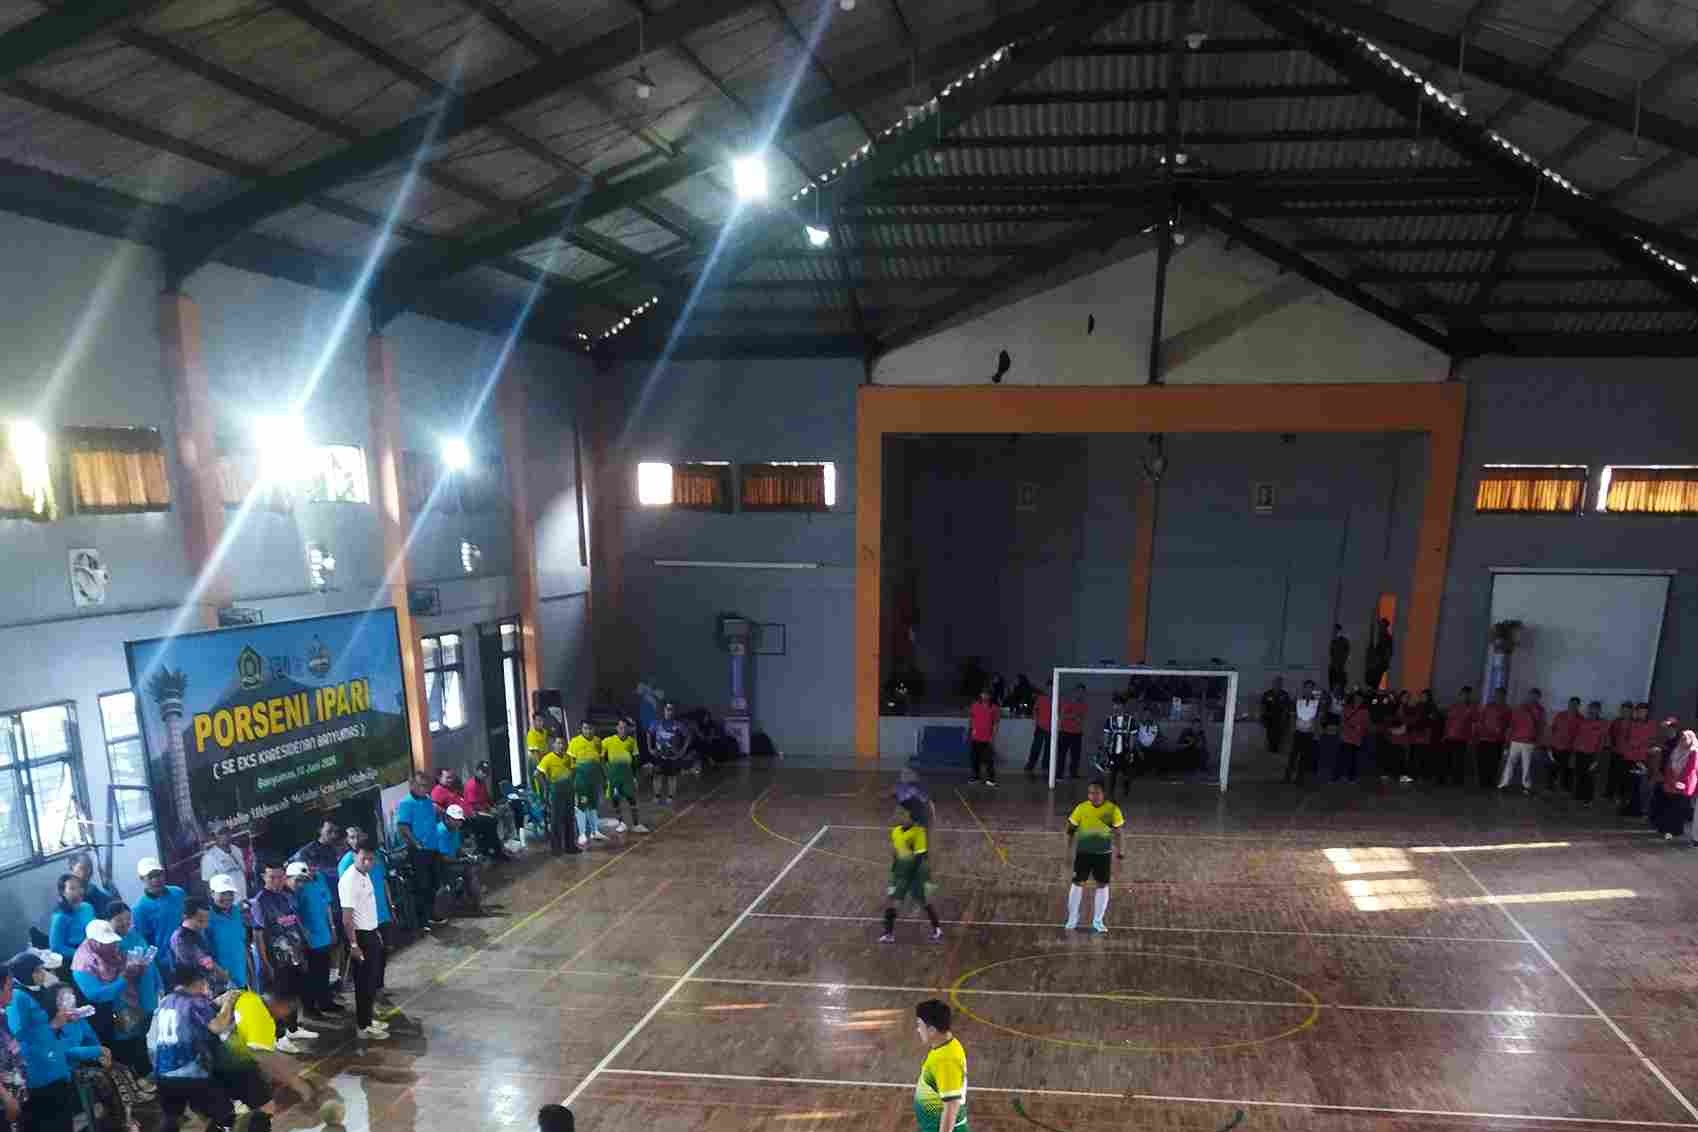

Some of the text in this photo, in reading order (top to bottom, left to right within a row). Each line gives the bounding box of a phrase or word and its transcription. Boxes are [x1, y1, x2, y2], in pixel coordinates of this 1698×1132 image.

[193, 679, 370, 753] PORSENI IPARI
[237, 753, 258, 771] EKS
